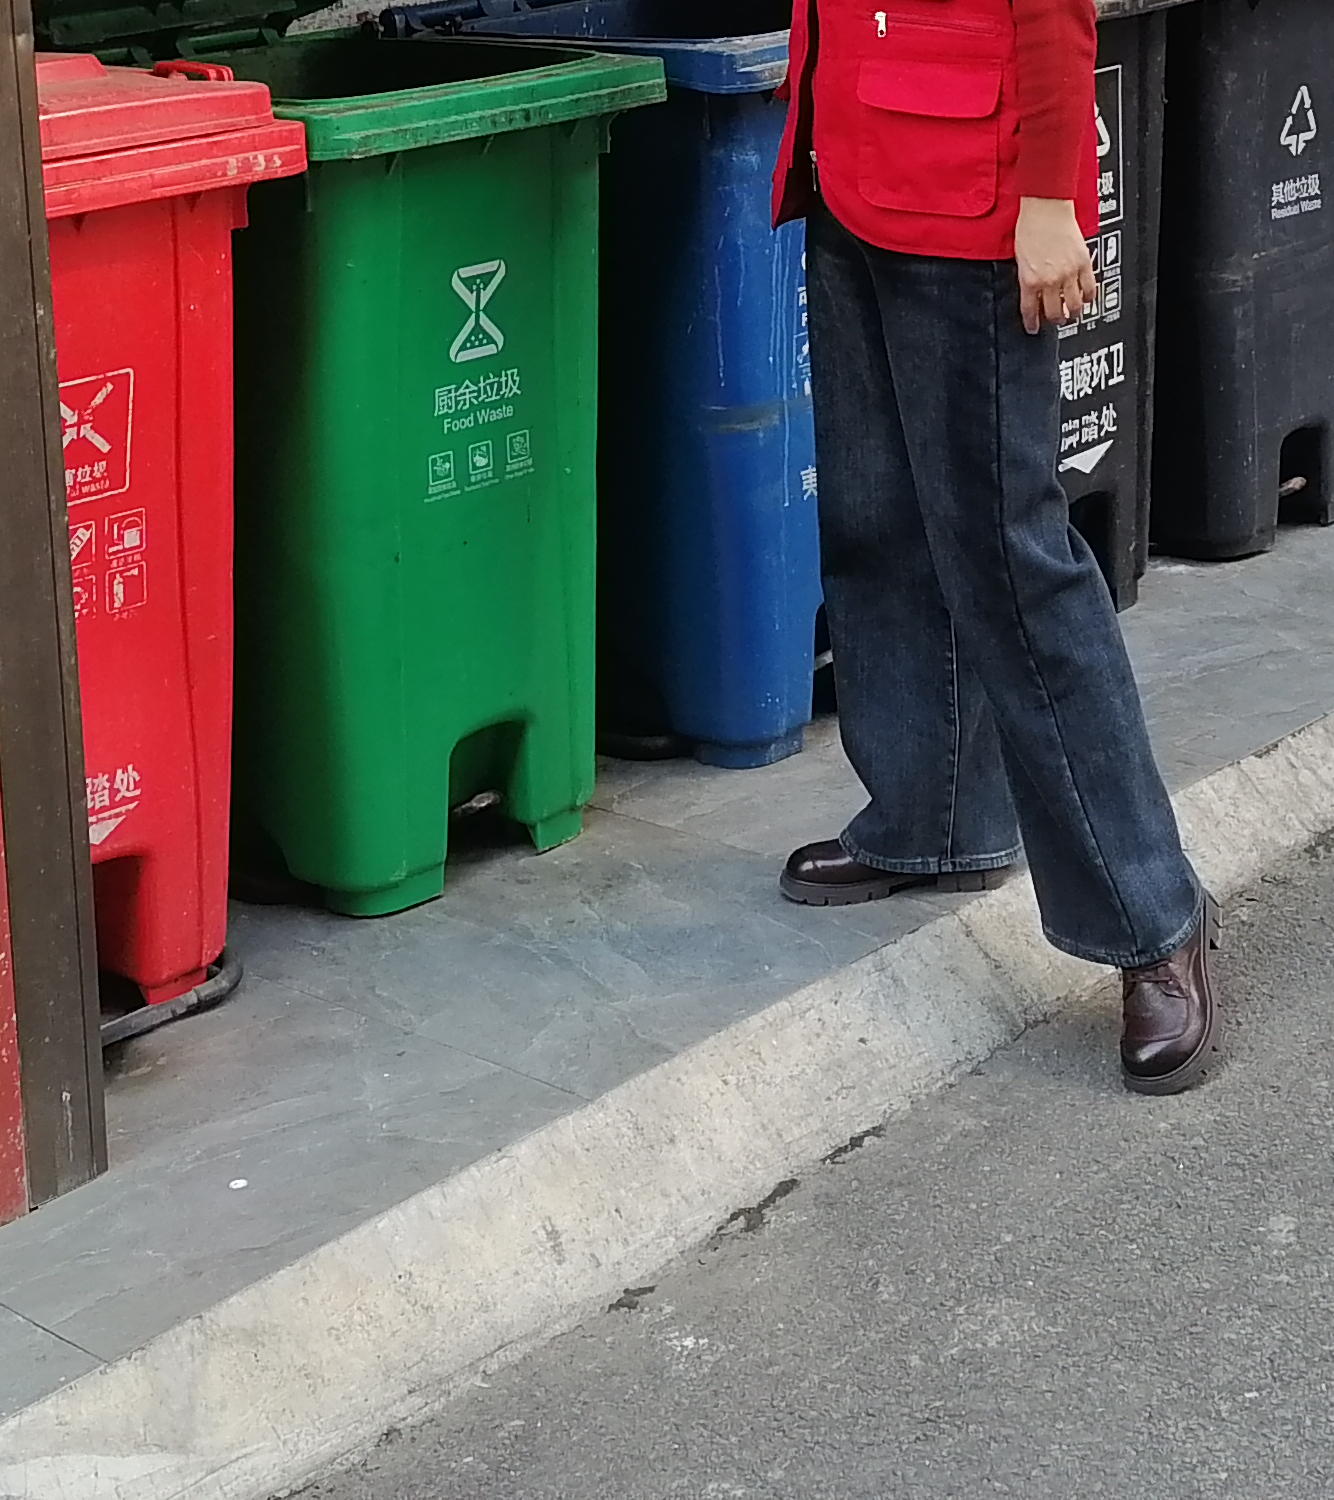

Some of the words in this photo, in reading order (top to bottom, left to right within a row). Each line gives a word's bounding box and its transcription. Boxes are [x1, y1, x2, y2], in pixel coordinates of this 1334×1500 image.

[1271, 173, 1321, 206] 其他垃圾
[1059, 341, 1124, 401] 夷陵环卫
[434, 368, 522, 417] 厨余垃圾
[443, 413, 474, 434] Food
[477, 404, 514, 425] Waste
